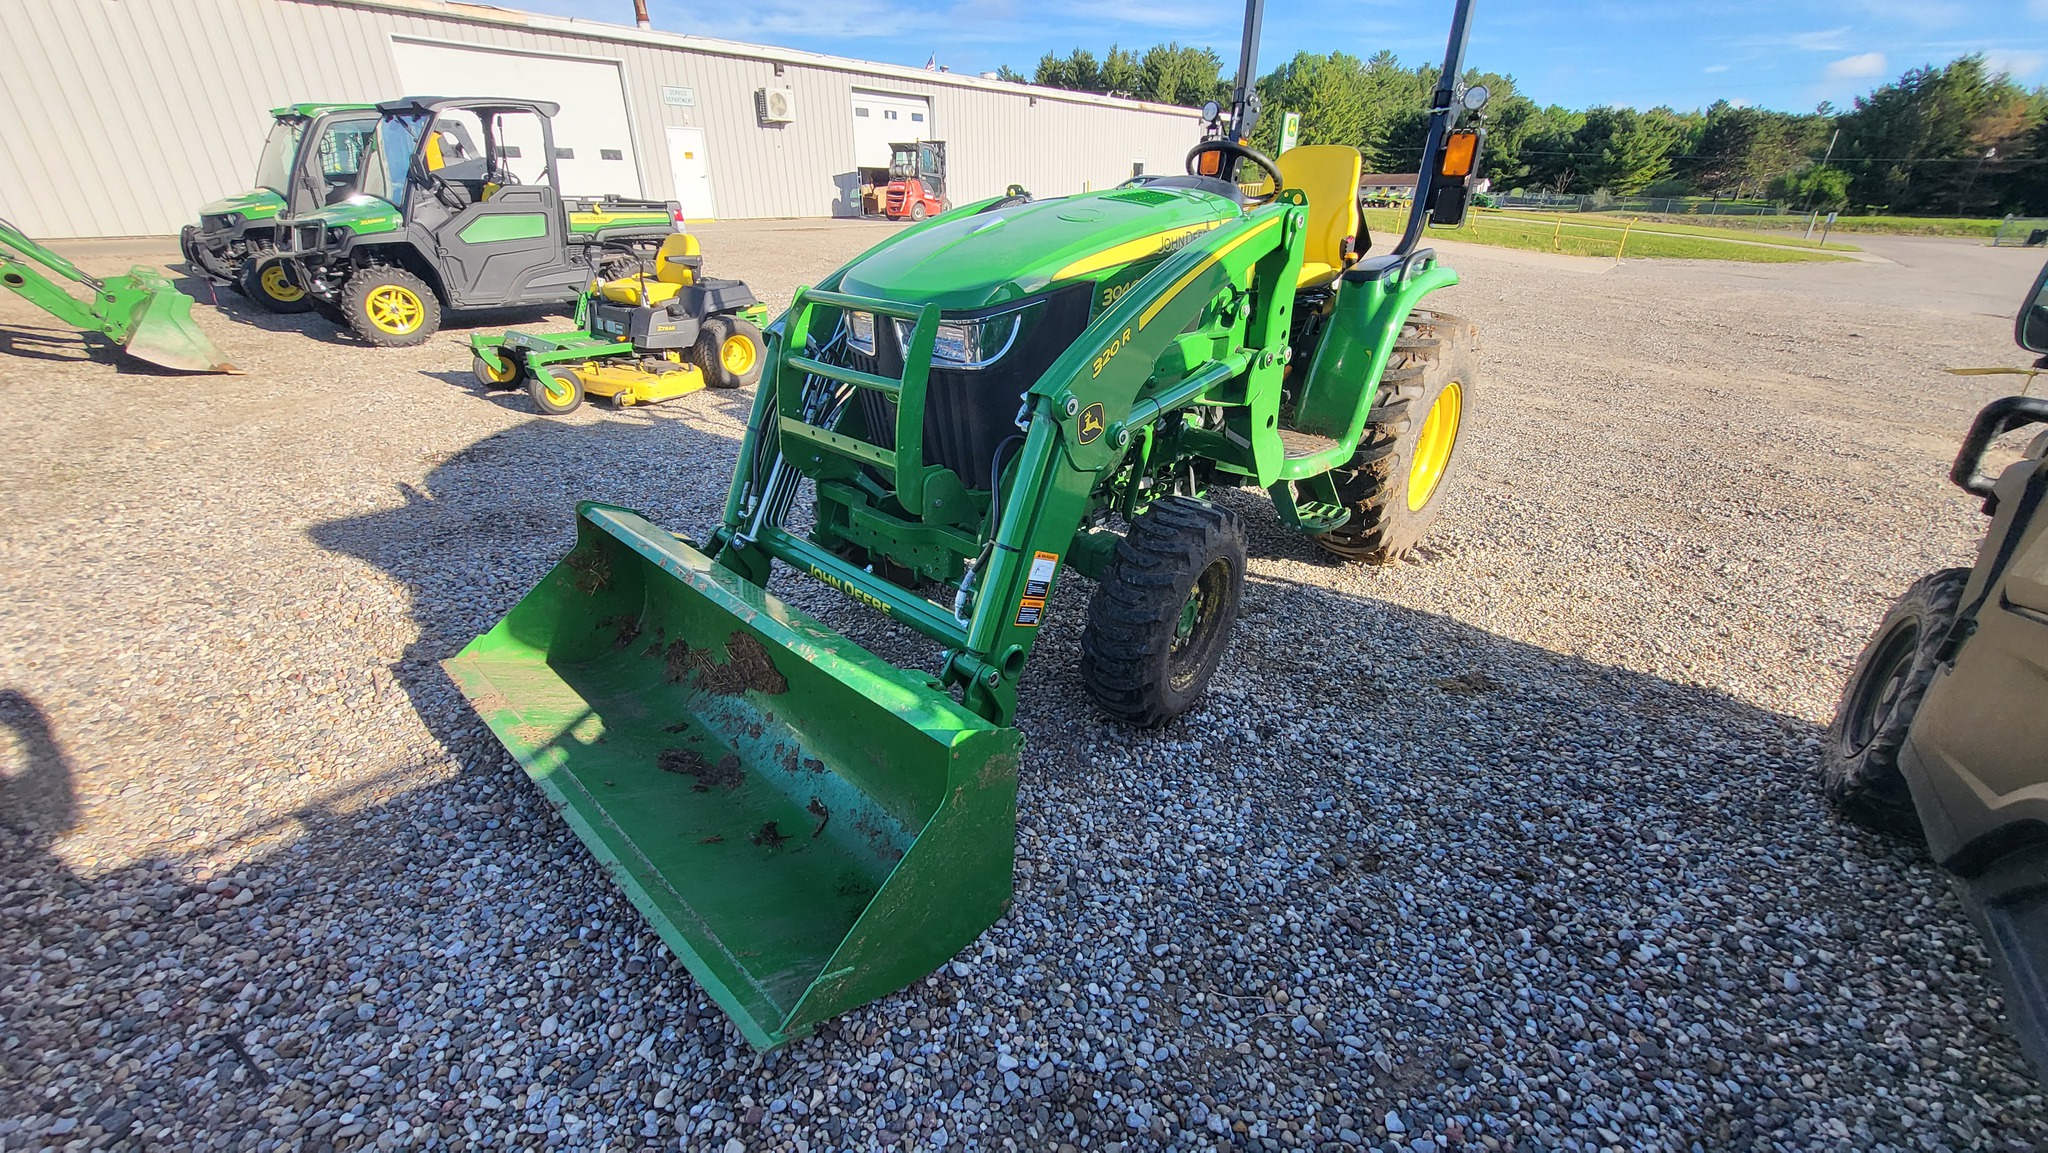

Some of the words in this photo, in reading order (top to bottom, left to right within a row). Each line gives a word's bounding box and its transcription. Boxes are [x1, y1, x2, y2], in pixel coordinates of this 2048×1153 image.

[666, 96, 693, 104] DEPARTMENT
[1158, 235, 1185, 254] JOHN
[1092, 339, 1120, 379] 320
[1121, 326, 1131, 347] R
[810, 563, 841, 590] JOHN
[844, 580, 892, 617] DEERE
